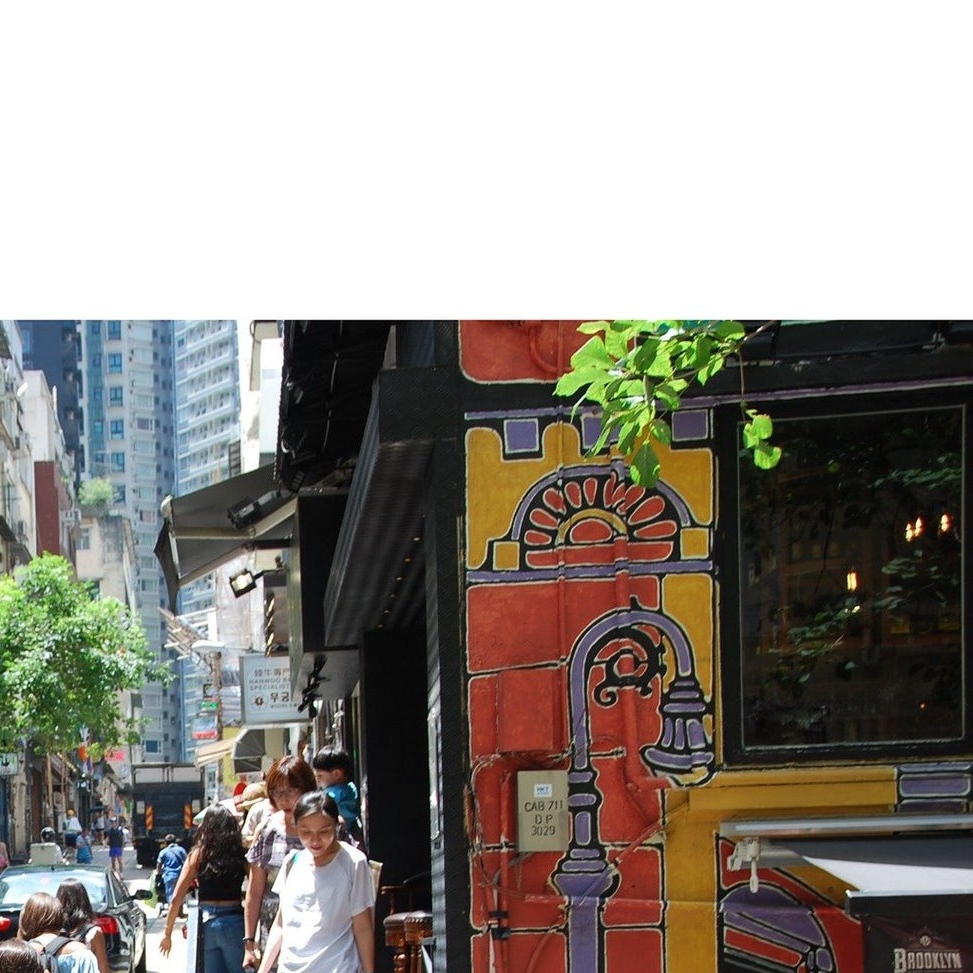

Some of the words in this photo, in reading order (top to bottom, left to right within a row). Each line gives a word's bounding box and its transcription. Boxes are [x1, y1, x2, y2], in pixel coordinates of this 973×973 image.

[524, 801, 545, 812] CAB
[548, 800, 563, 811] 711
[531, 825, 556, 836] 3029
